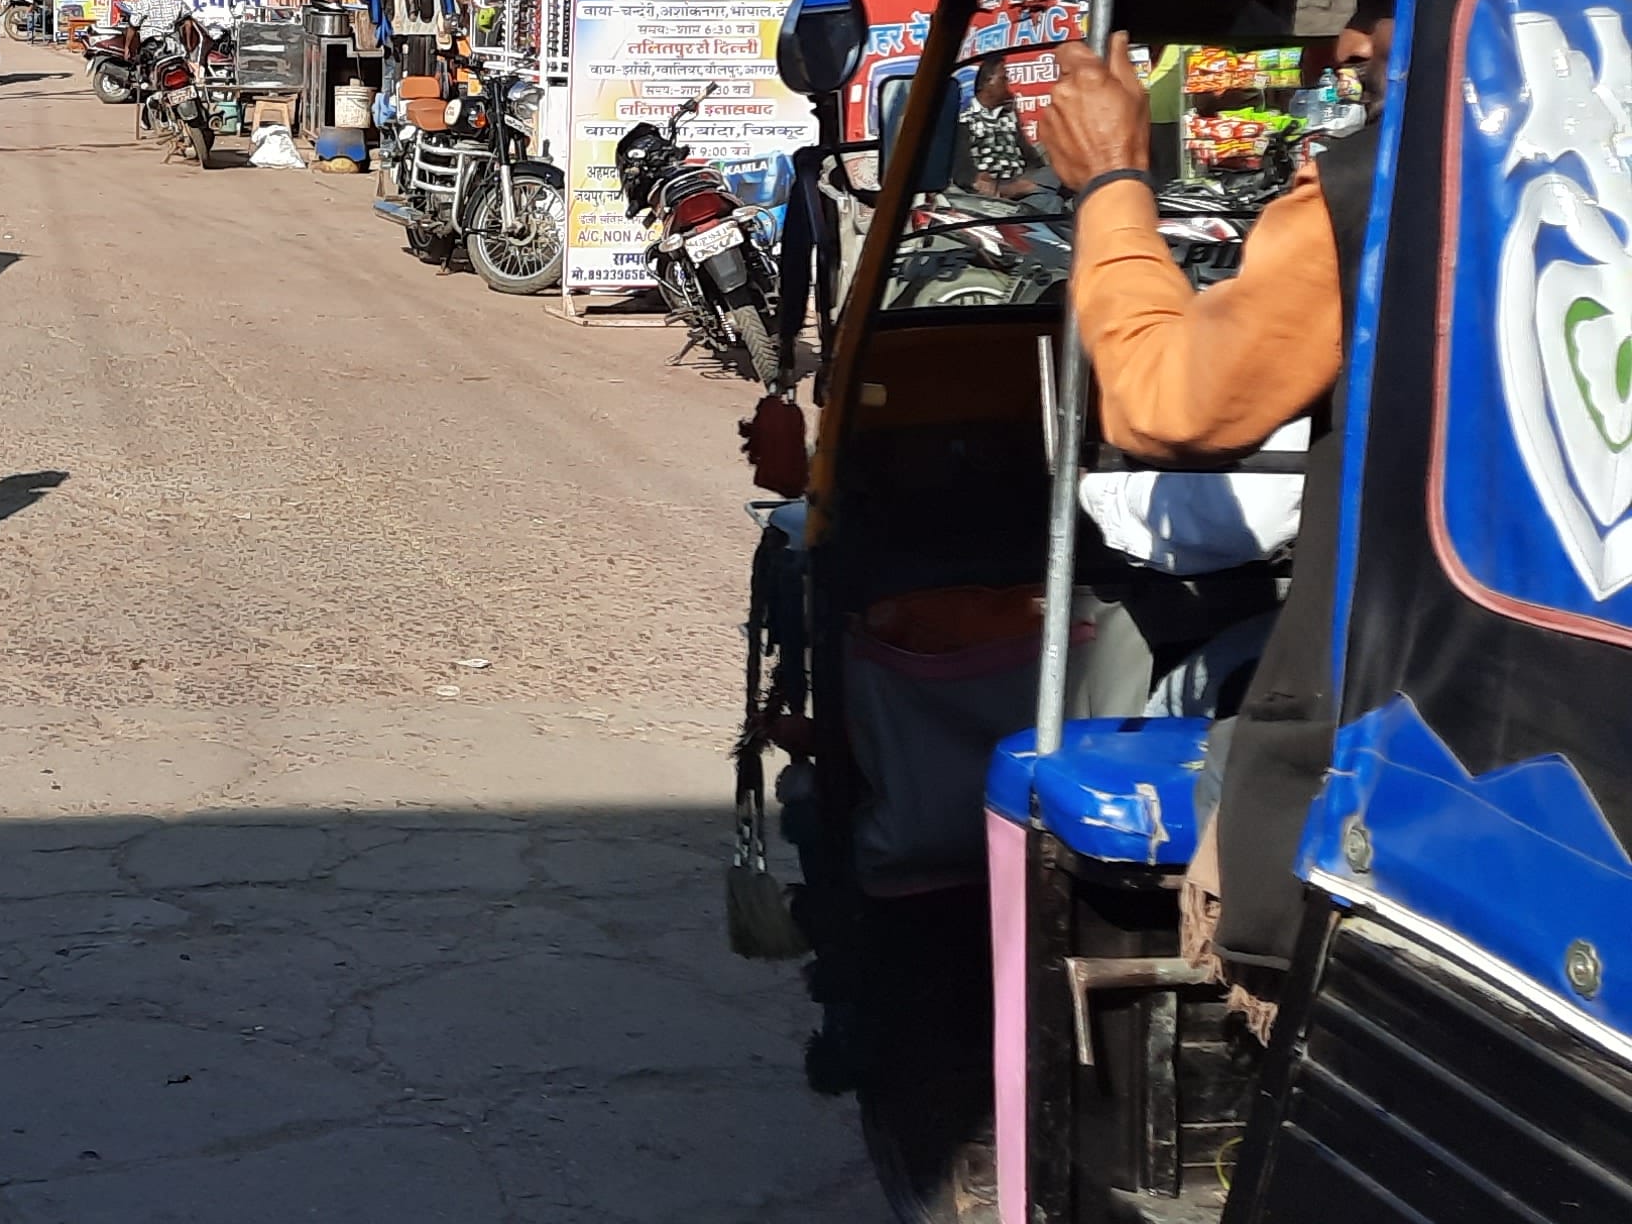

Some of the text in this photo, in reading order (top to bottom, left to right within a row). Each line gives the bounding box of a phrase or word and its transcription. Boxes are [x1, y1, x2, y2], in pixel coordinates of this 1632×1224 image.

[1015, 5, 1069, 48] A/C
[627, 38, 759, 59] ललितपुर से दिल्ली
[723, 160, 768, 176] KAMLA
[634, 230, 657, 243] A/C
